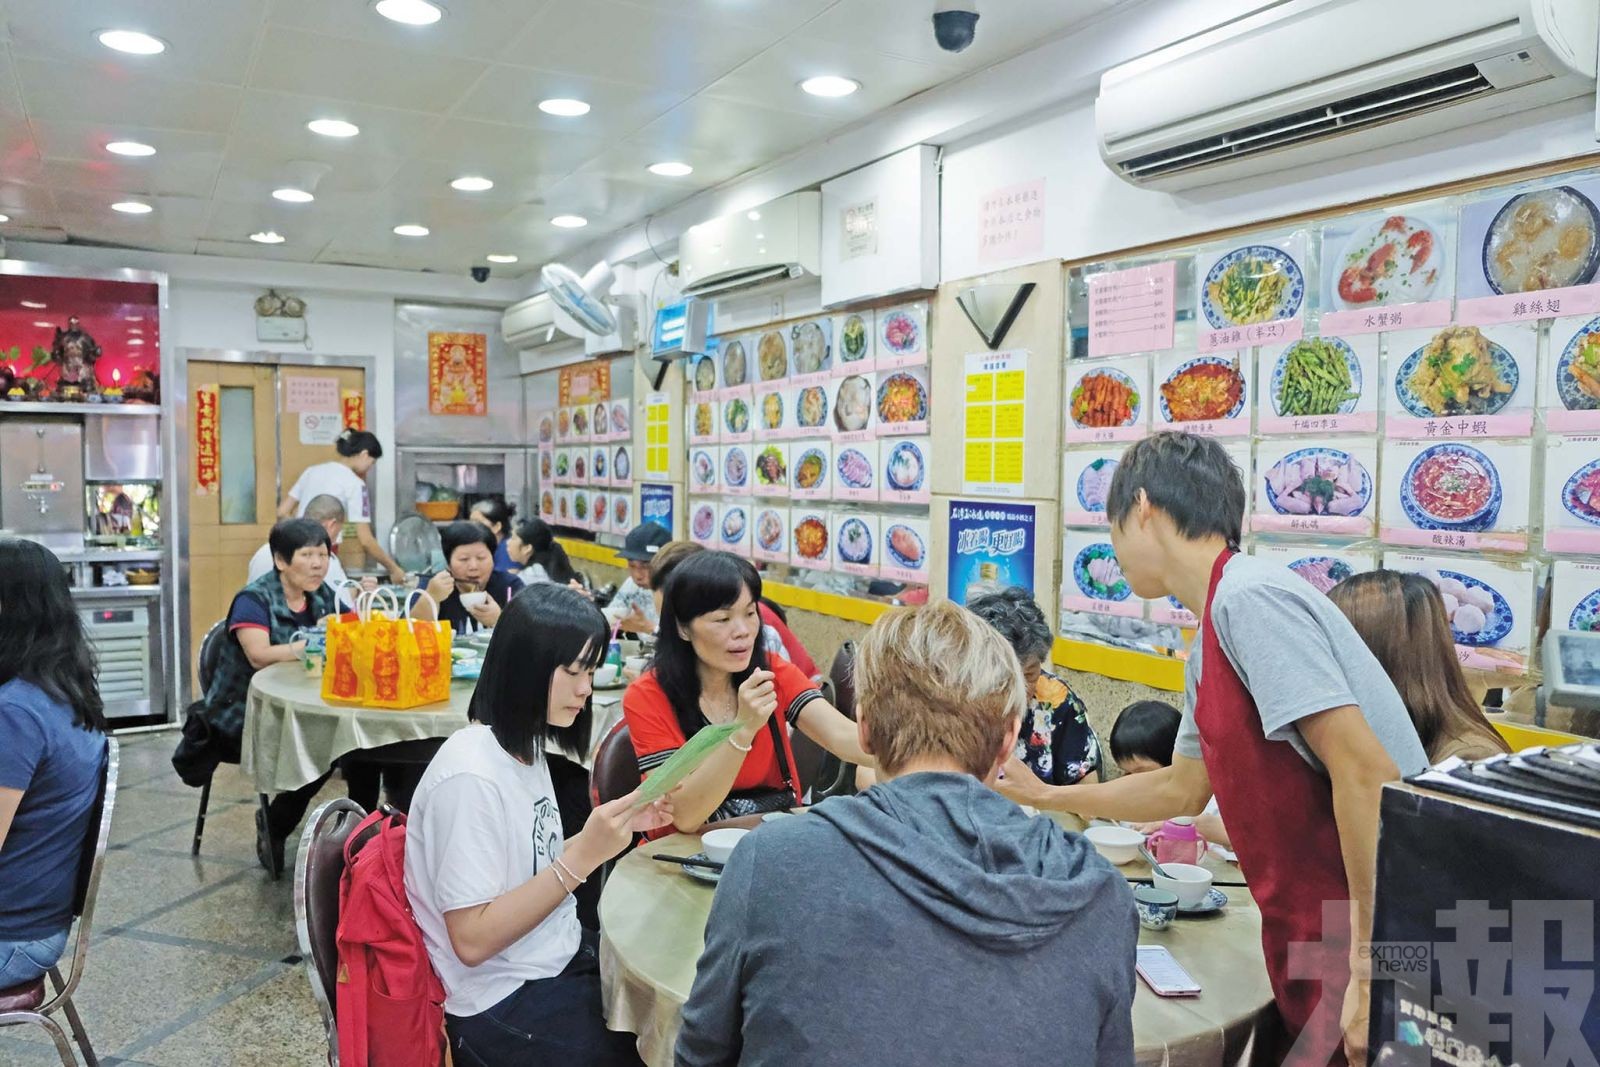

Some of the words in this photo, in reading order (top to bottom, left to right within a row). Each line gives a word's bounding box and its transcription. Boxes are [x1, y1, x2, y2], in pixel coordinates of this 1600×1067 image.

[1513, 299, 1560, 317] 雞絲翅
[1364, 312, 1402, 327] 水蟹粥
[1424, 420, 1487, 436] 黃金中蝦
[1432, 534, 1466, 547] 酸辣湯
